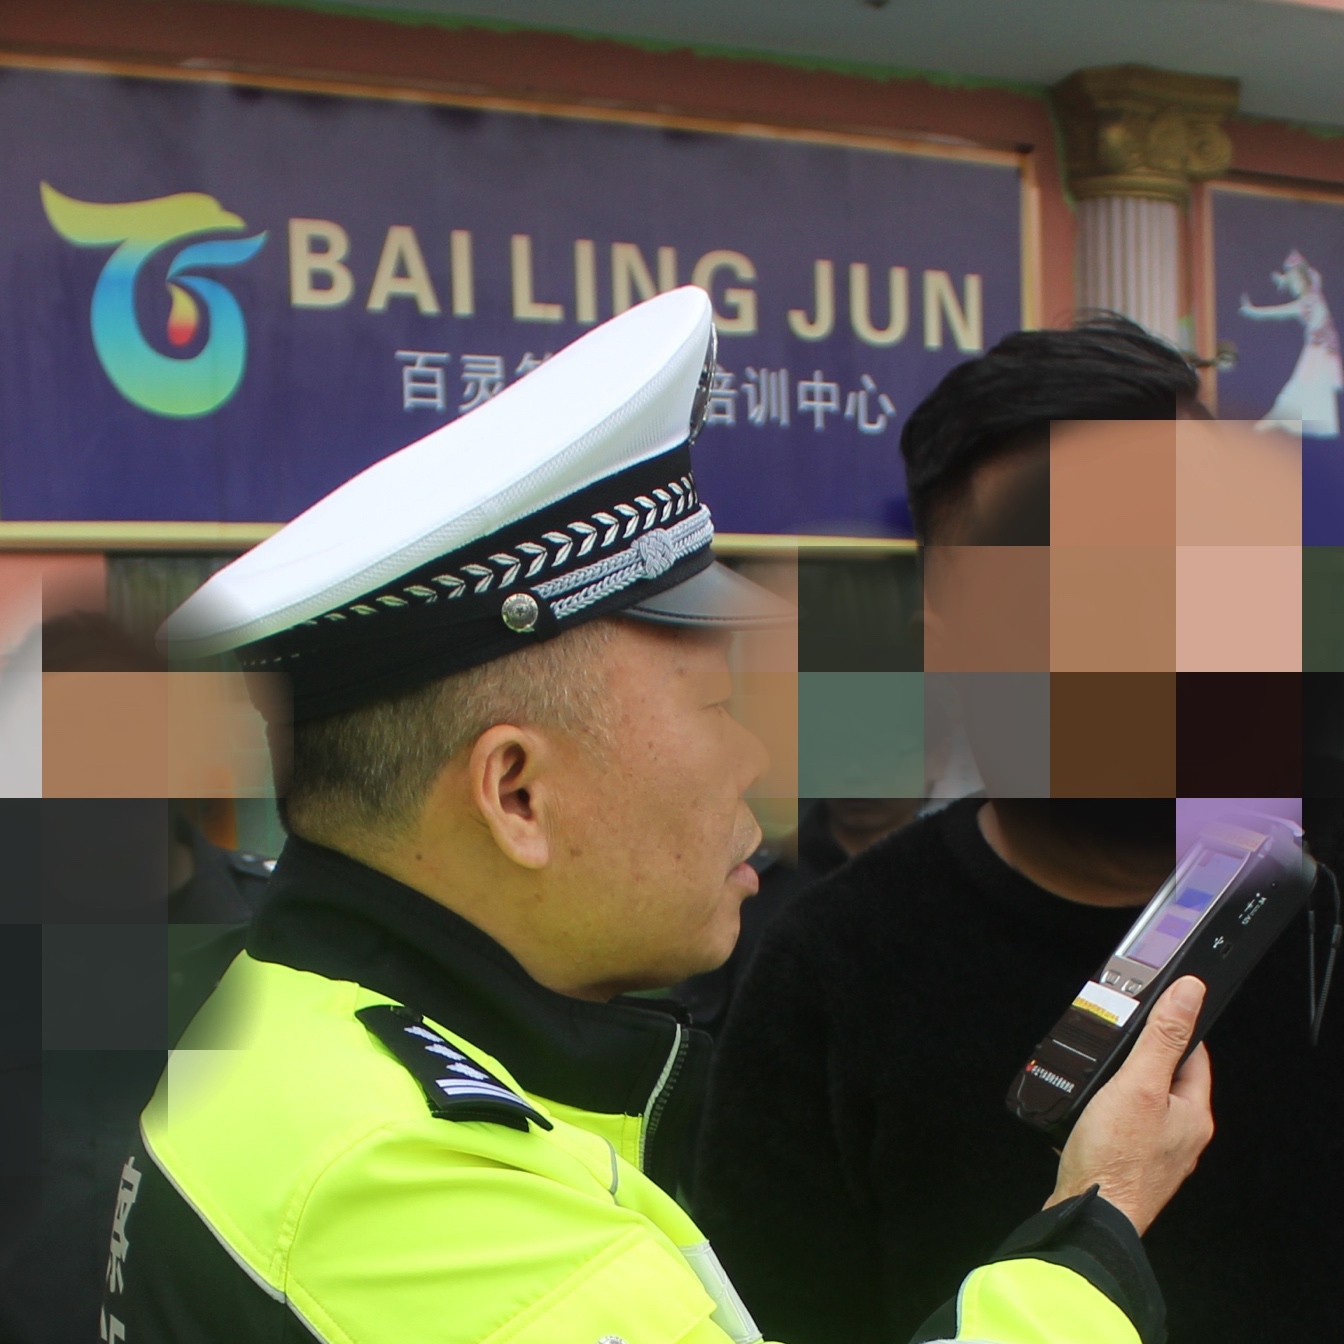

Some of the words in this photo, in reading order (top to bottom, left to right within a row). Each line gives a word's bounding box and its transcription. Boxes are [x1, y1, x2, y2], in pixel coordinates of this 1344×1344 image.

[288, 216, 476, 318] BAI
[511, 233, 757, 335] LING
[787, 258, 983, 354] JUN
